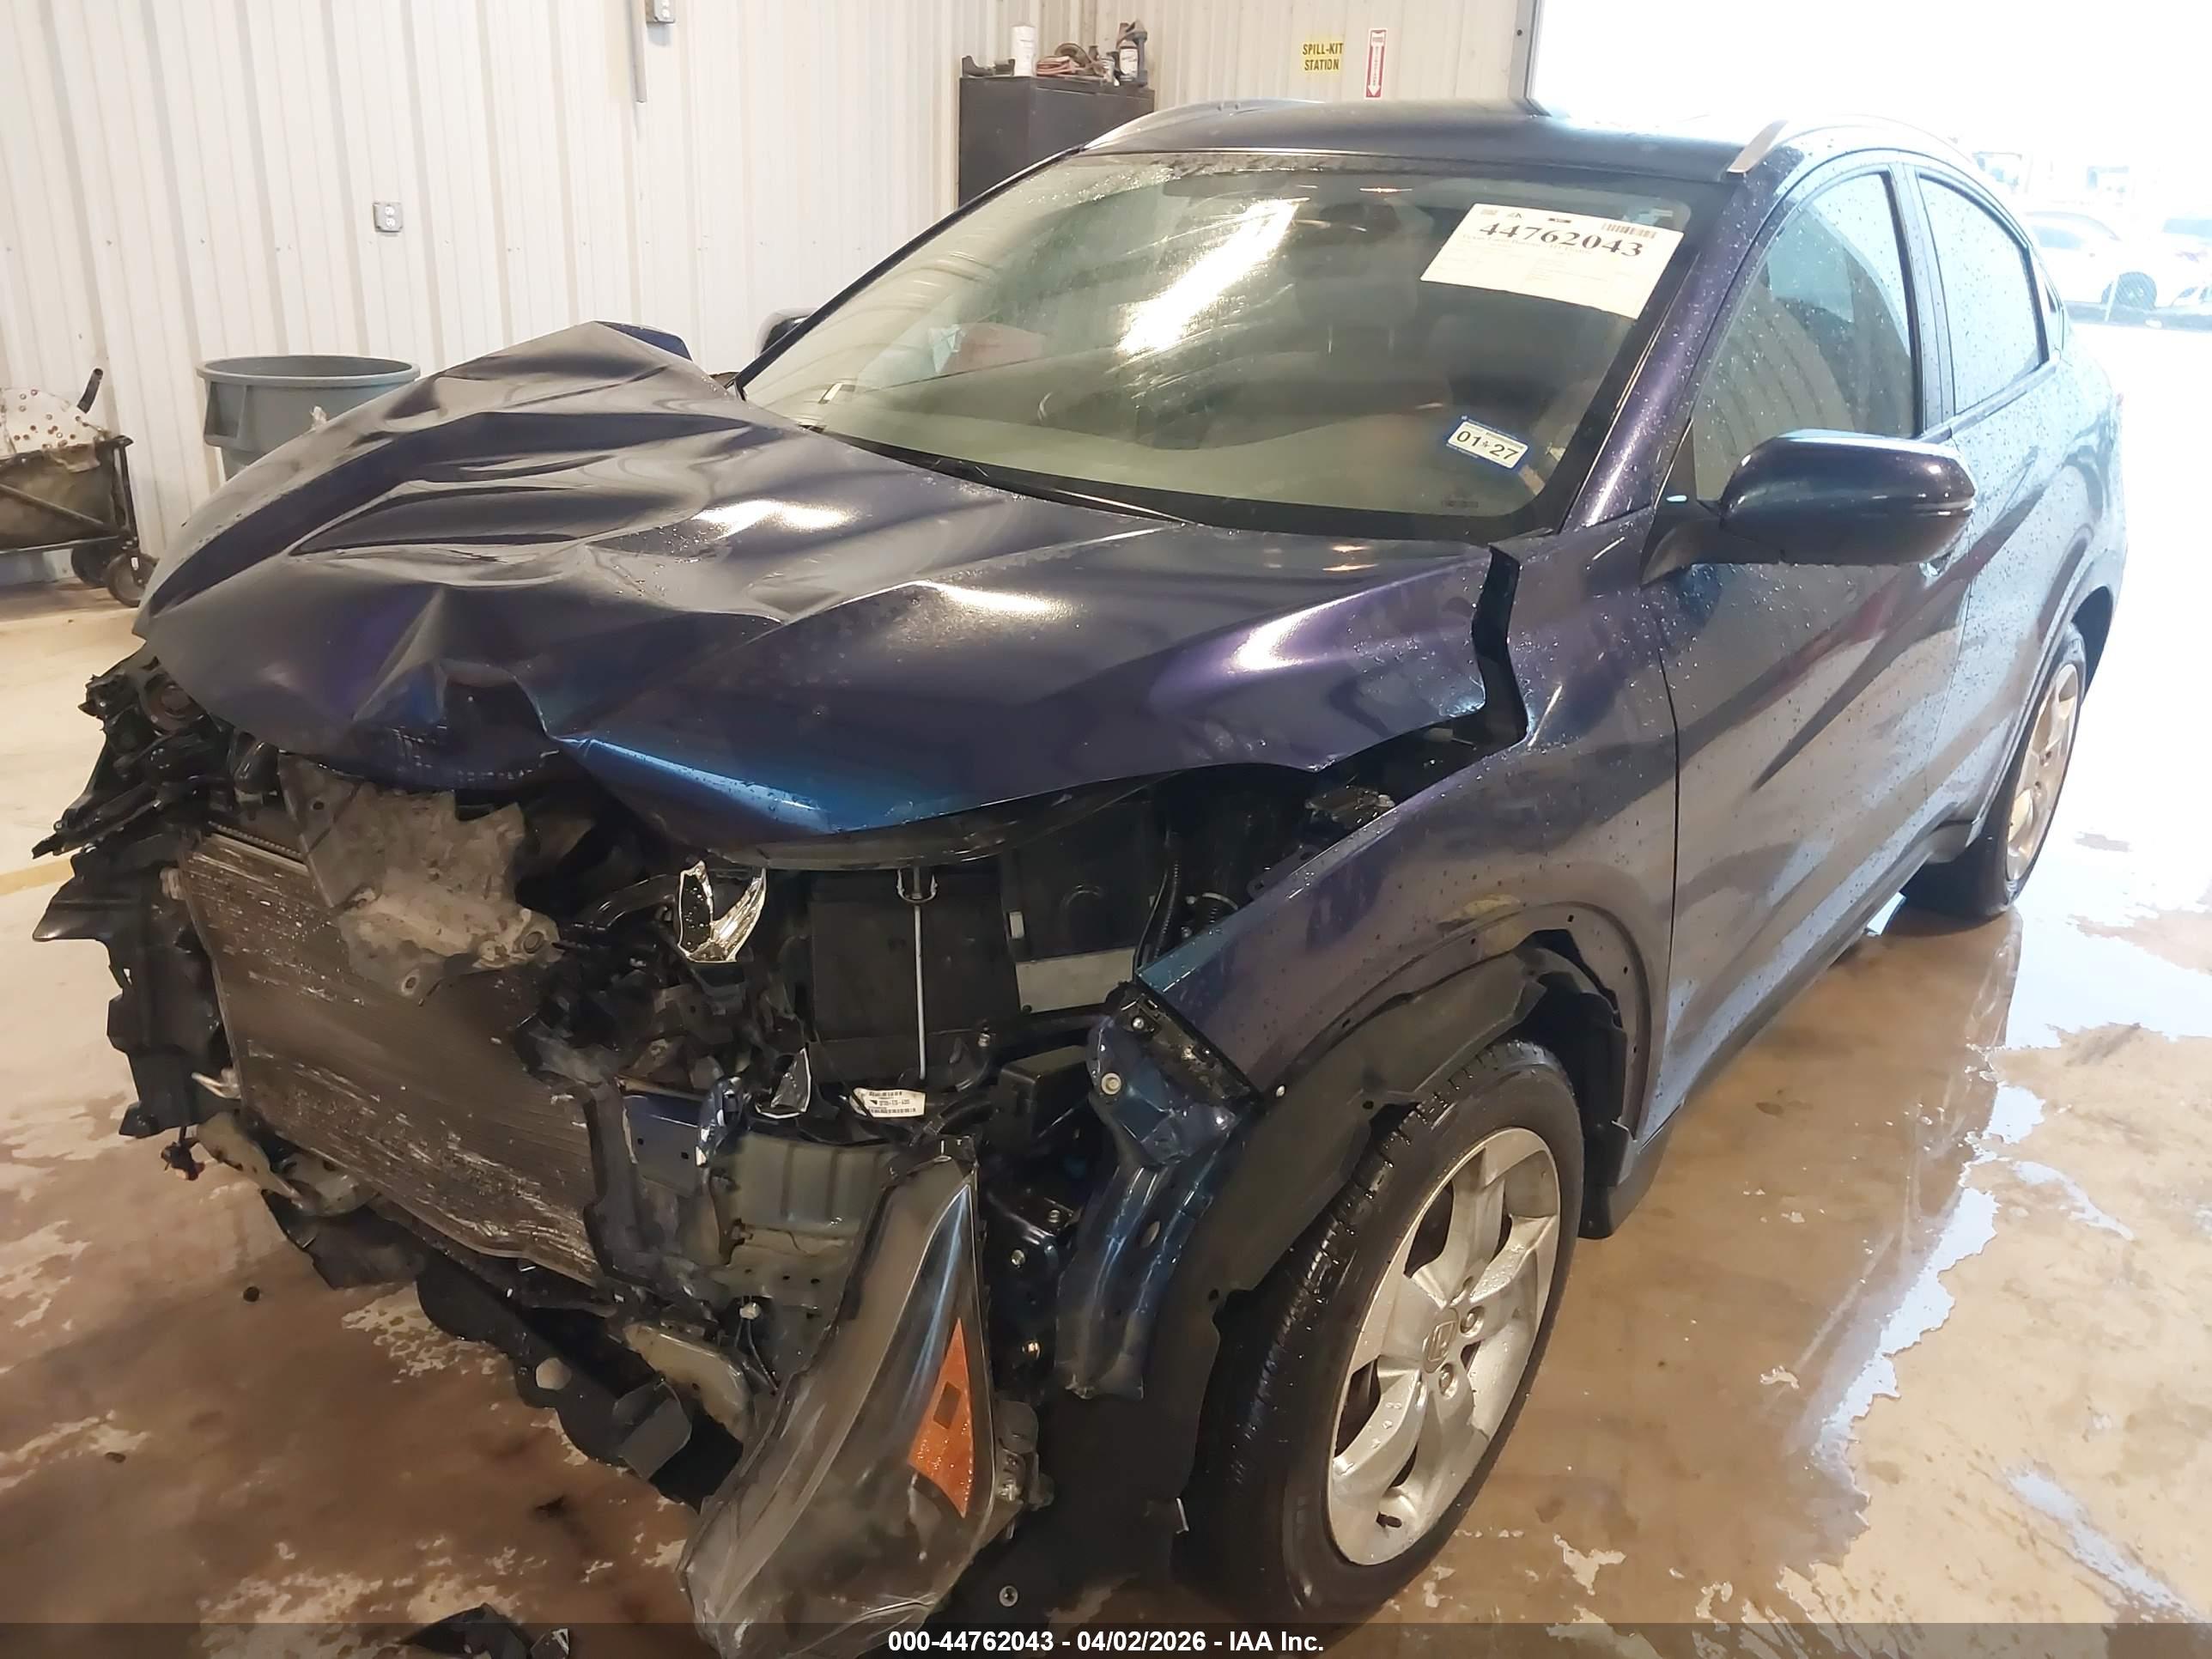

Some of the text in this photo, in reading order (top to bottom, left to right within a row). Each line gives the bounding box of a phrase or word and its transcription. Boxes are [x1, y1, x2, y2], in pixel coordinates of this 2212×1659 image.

[1303, 43, 1343, 55] SPILL-KIT
[1304, 58, 1340, 70] STATION
[1479, 222, 1644, 258] 44762043
[1456, 430, 1482, 447] 01
[1489, 443, 1519, 460] 27
